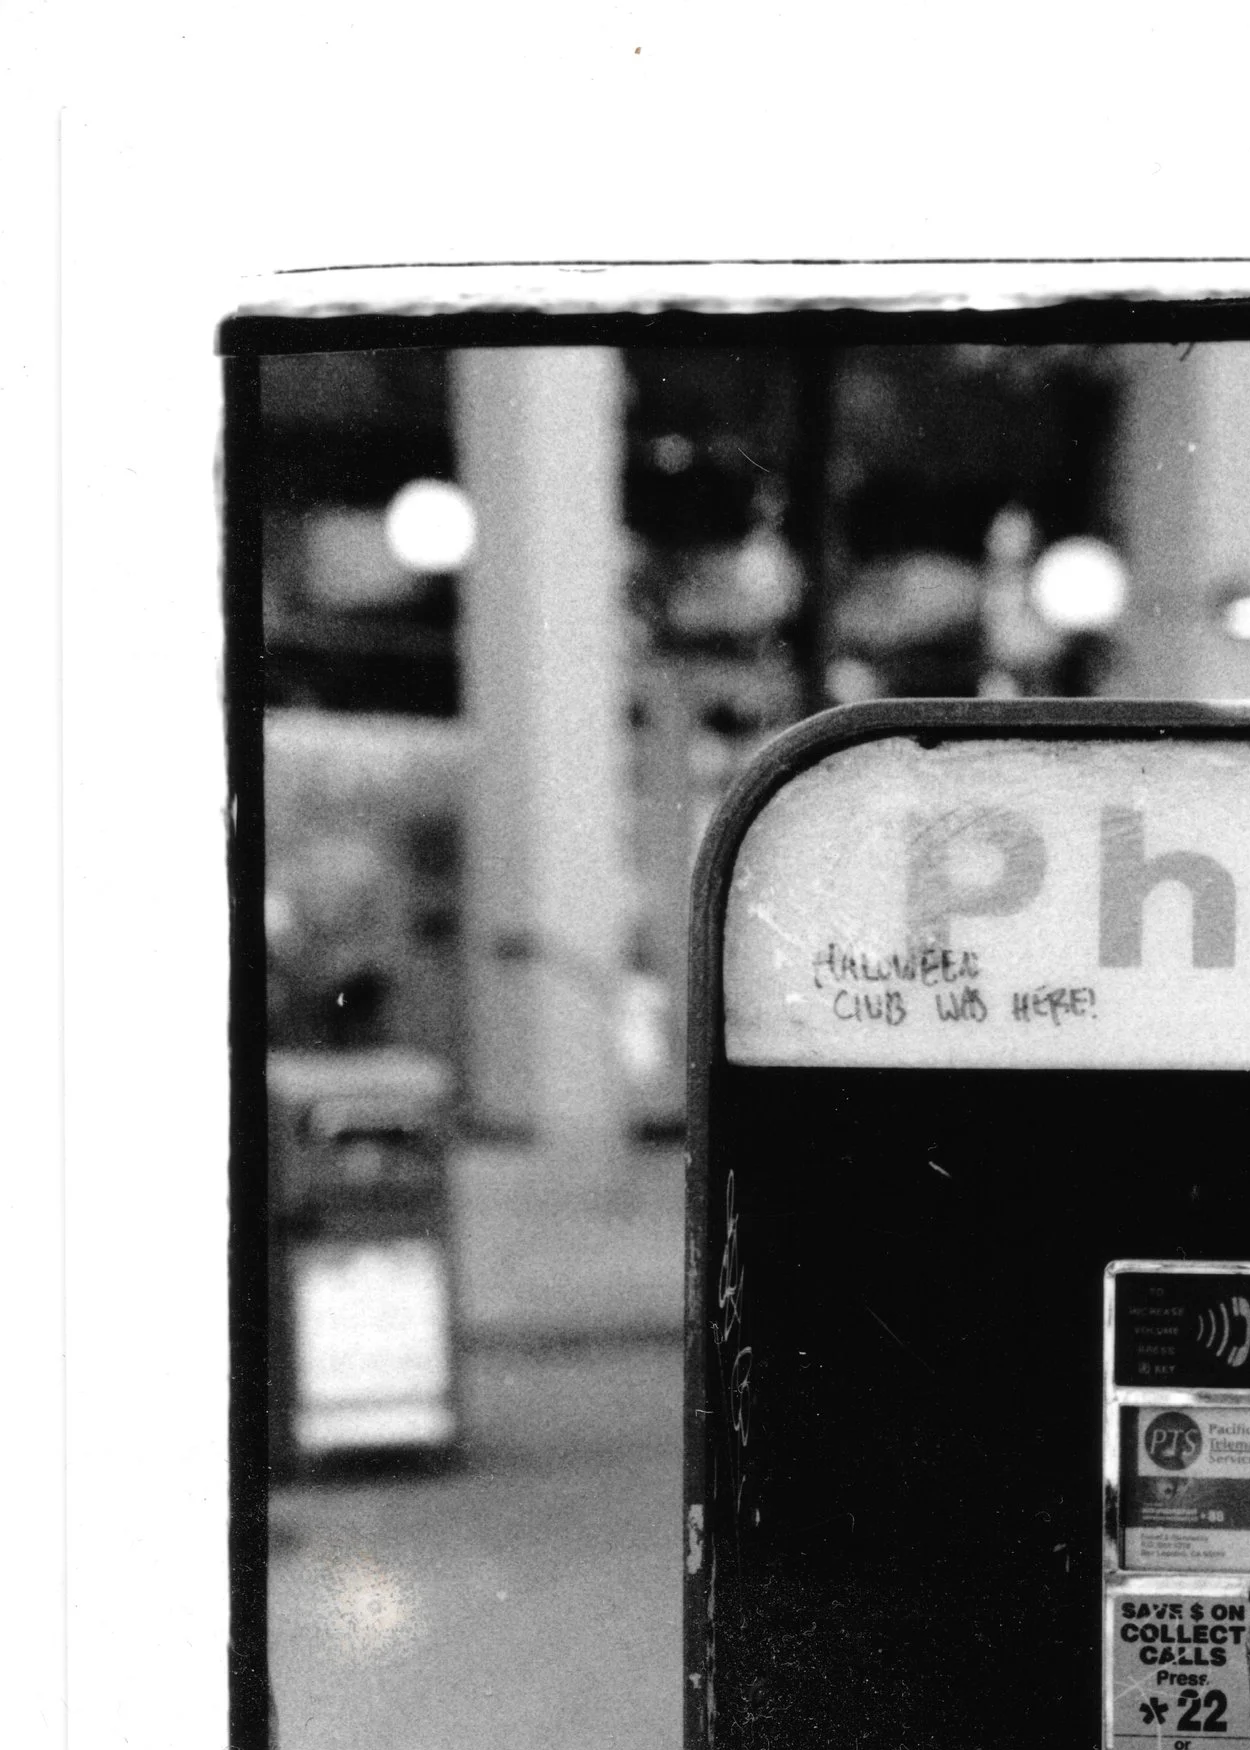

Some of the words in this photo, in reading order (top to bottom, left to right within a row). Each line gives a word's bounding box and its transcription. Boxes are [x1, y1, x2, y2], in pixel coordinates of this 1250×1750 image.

[833, 989, 907, 1026] CLUB
[1150, 1428, 1199, 1455] PTS
[1121, 1602, 1183, 1619] SAVE
[1190, 1602, 1204, 1622] $
[1211, 1604, 1245, 1621] ON
[1120, 1623, 1246, 1645] COLLECT
[1139, 1646, 1227, 1667] CALLS
[1174, 1740, 1192, 1750] or
